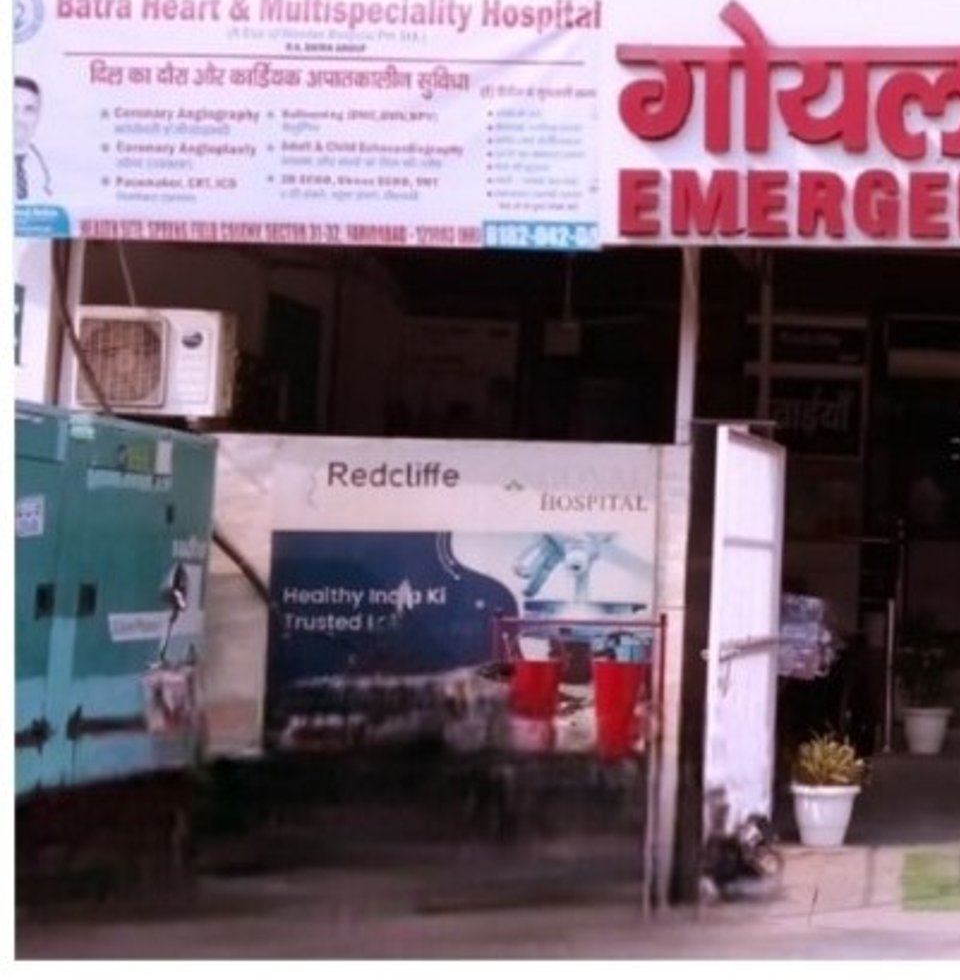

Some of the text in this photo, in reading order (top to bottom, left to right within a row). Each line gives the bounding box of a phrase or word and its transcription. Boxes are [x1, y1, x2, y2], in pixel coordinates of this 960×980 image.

[89, 59, 123, 85] दिल
[128, 65, 152, 85] का
[193, 61, 225, 86] और
[417, 65, 471, 100] सुविधा
[326, 461, 461, 489] Redcliffe
[539, 492, 649, 513] HOSPITAL
[282, 586, 363, 606] Healthy
[426, 587, 447, 605] Ki
[283, 616, 361, 633] Trusted
